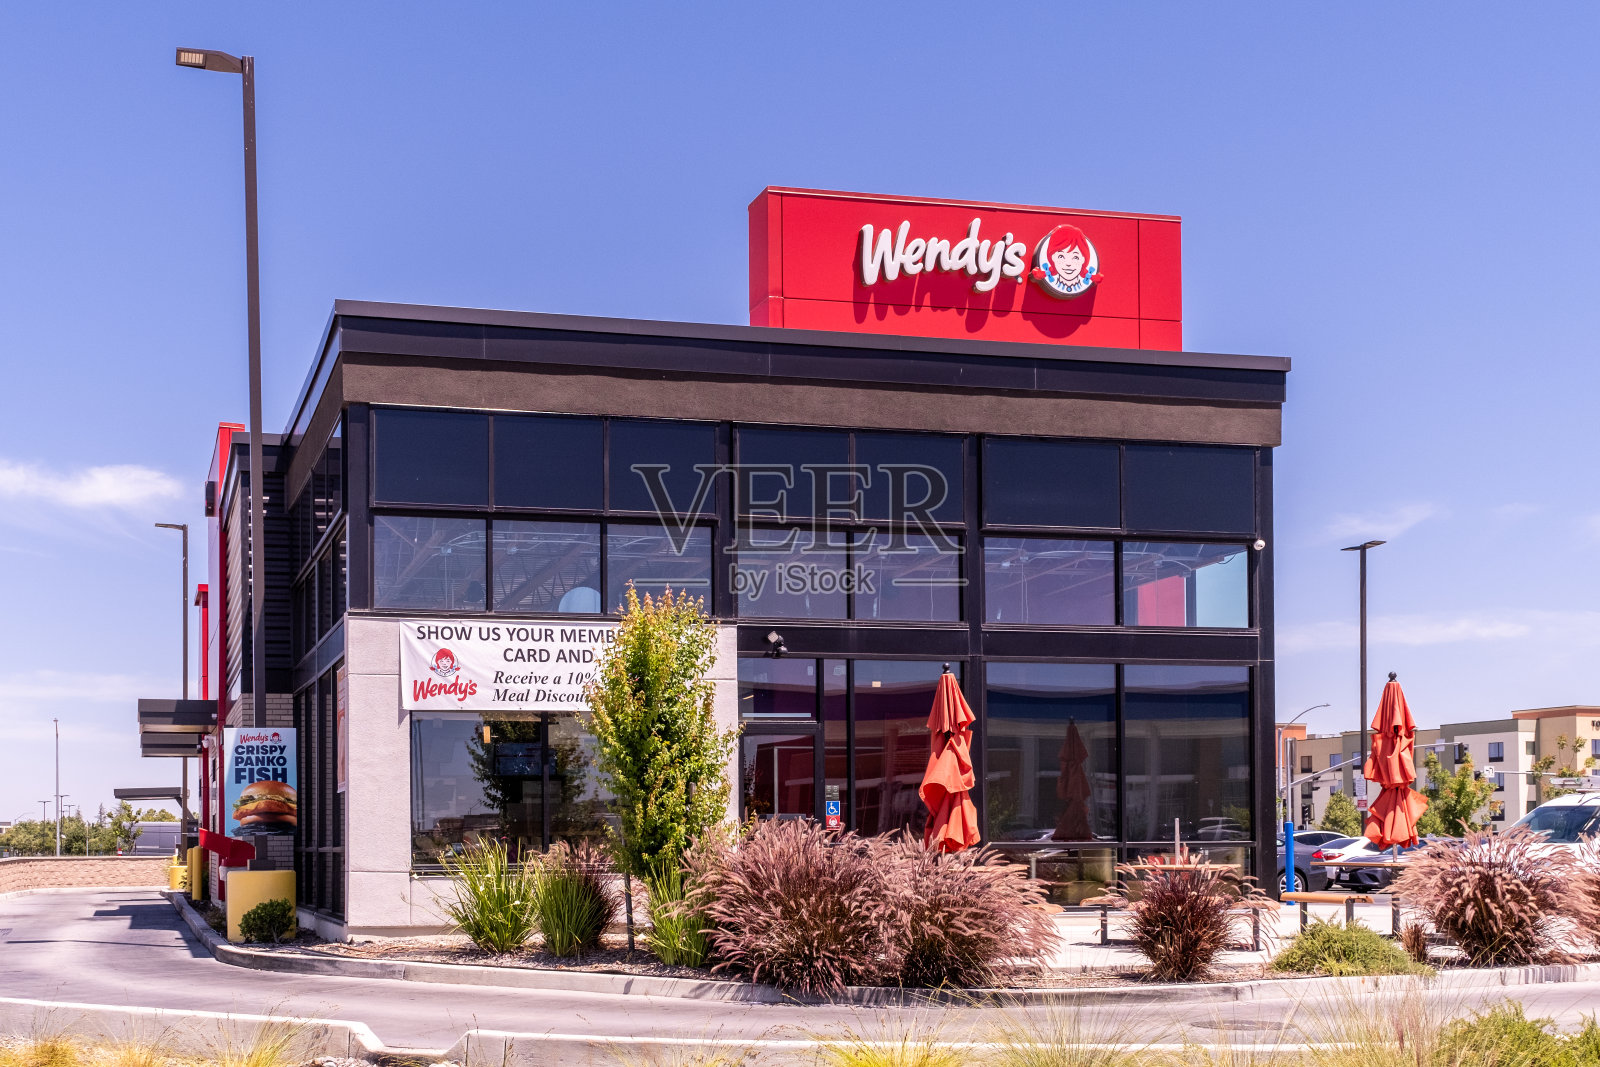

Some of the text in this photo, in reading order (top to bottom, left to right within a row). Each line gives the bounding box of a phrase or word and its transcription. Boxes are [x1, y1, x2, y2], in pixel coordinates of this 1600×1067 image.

[860, 217, 1027, 292] Wendy's
[416, 625, 473, 641] SHOW
[478, 626, 501, 641] US
[505, 627, 555, 643] YOUR
[503, 647, 594, 664] CARD AND
[493, 670, 598, 686] Receive a 10%
[413, 674, 478, 703] Wendy's
[492, 688, 585, 703] Meal Discou
[240, 732, 268, 744] Wendy's
[234, 744, 287, 755] CRISPY
[234, 755, 287, 767] PANKO
[234, 767, 287, 784] FISH
